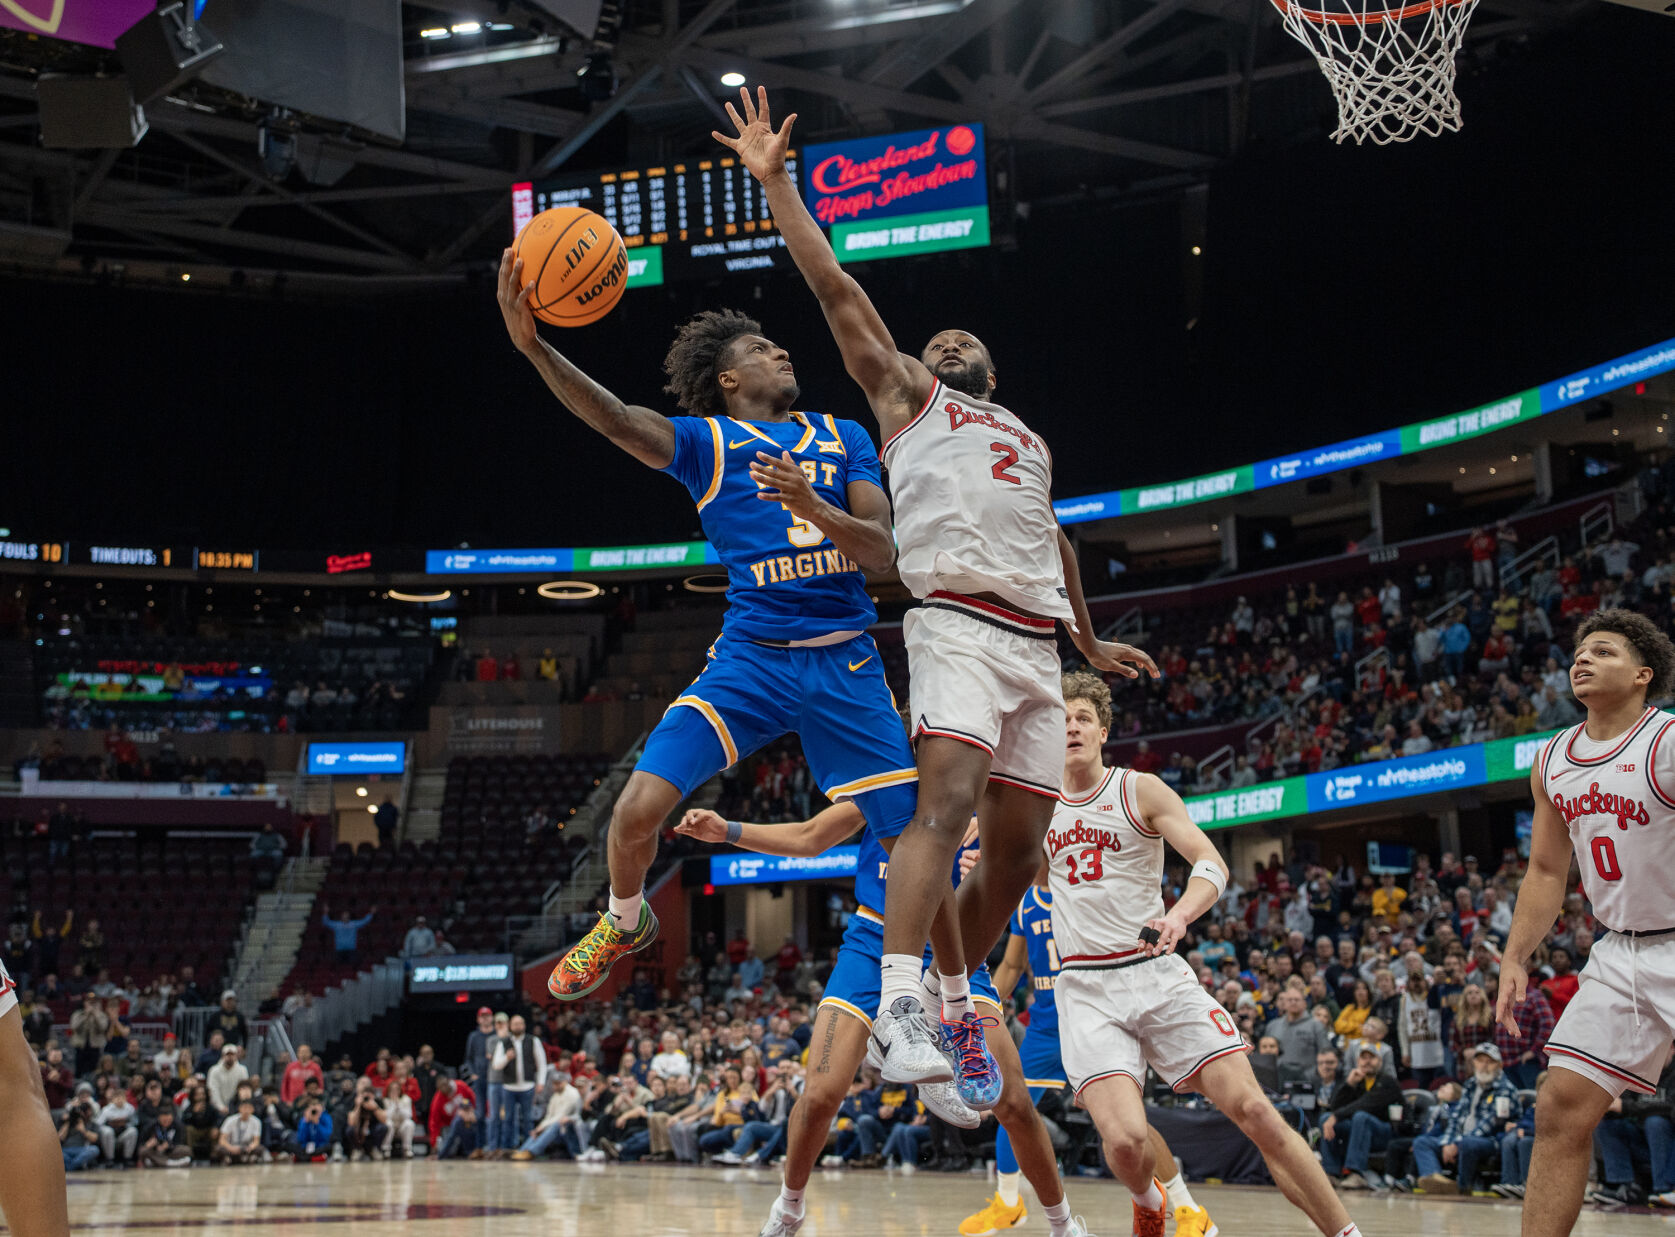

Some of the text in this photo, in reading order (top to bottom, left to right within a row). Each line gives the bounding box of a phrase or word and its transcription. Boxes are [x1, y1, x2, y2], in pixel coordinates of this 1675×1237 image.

[812, 131, 940, 195] Cleveland
[815, 159, 977, 224] Hoops Showdown
[845, 219, 974, 250] BRING THE ENERGY
[575, 244, 628, 306] Wilson
[1419, 398, 1523, 444] BRING THE ENERGY
[990, 441, 1022, 485] 2
[42, 543, 62, 562] 10
[162, 548, 171, 567] 1
[1215, 794, 1237, 820] THE
[1238, 786, 1284, 817] ENERGY
[1553, 782, 1650, 830] Buckeyes
[1047, 819, 1121, 859] Buckeyes
[1590, 836, 1622, 881] 0
[1066, 849, 1103, 886] 13
